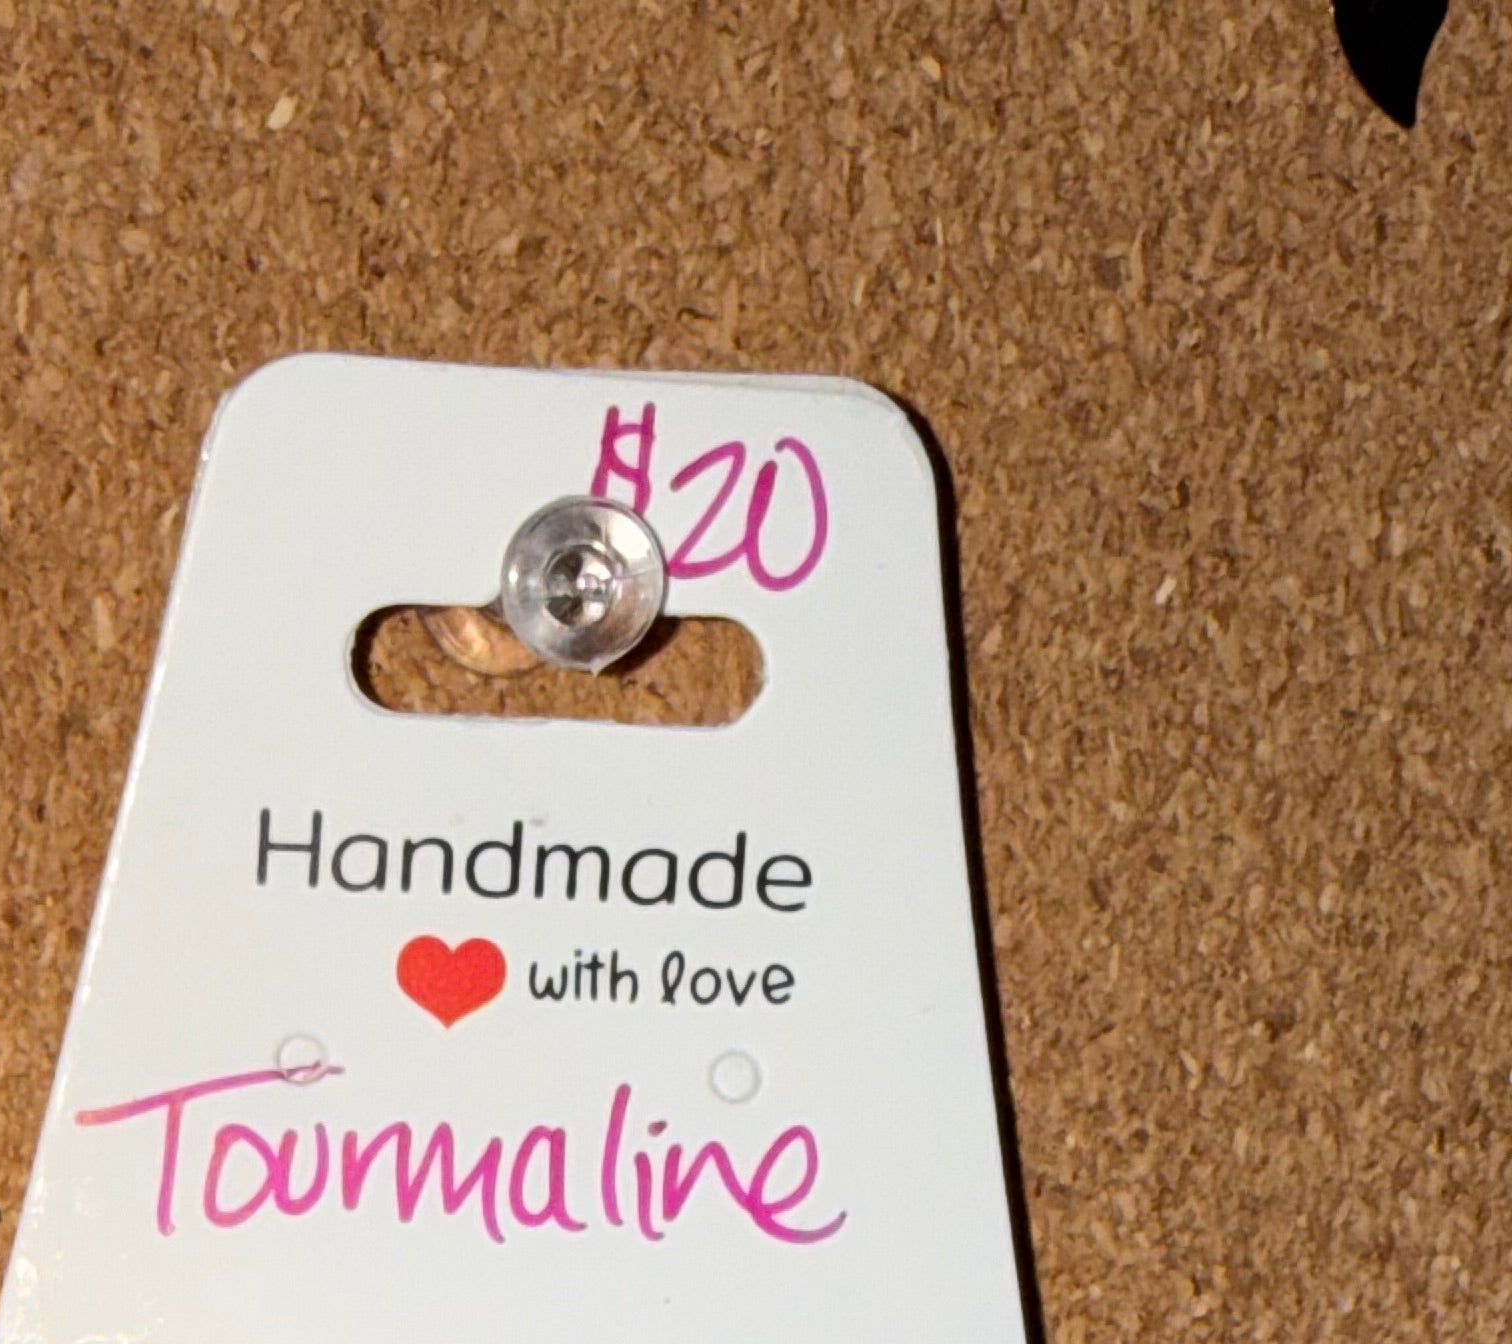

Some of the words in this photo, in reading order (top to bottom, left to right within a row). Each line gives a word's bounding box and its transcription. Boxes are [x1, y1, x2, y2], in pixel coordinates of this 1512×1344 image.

[256, 807, 814, 912] Handmade
[528, 949, 640, 1004] with
[660, 949, 796, 1007] love
[75, 1060, 848, 1246] Tourmaline
